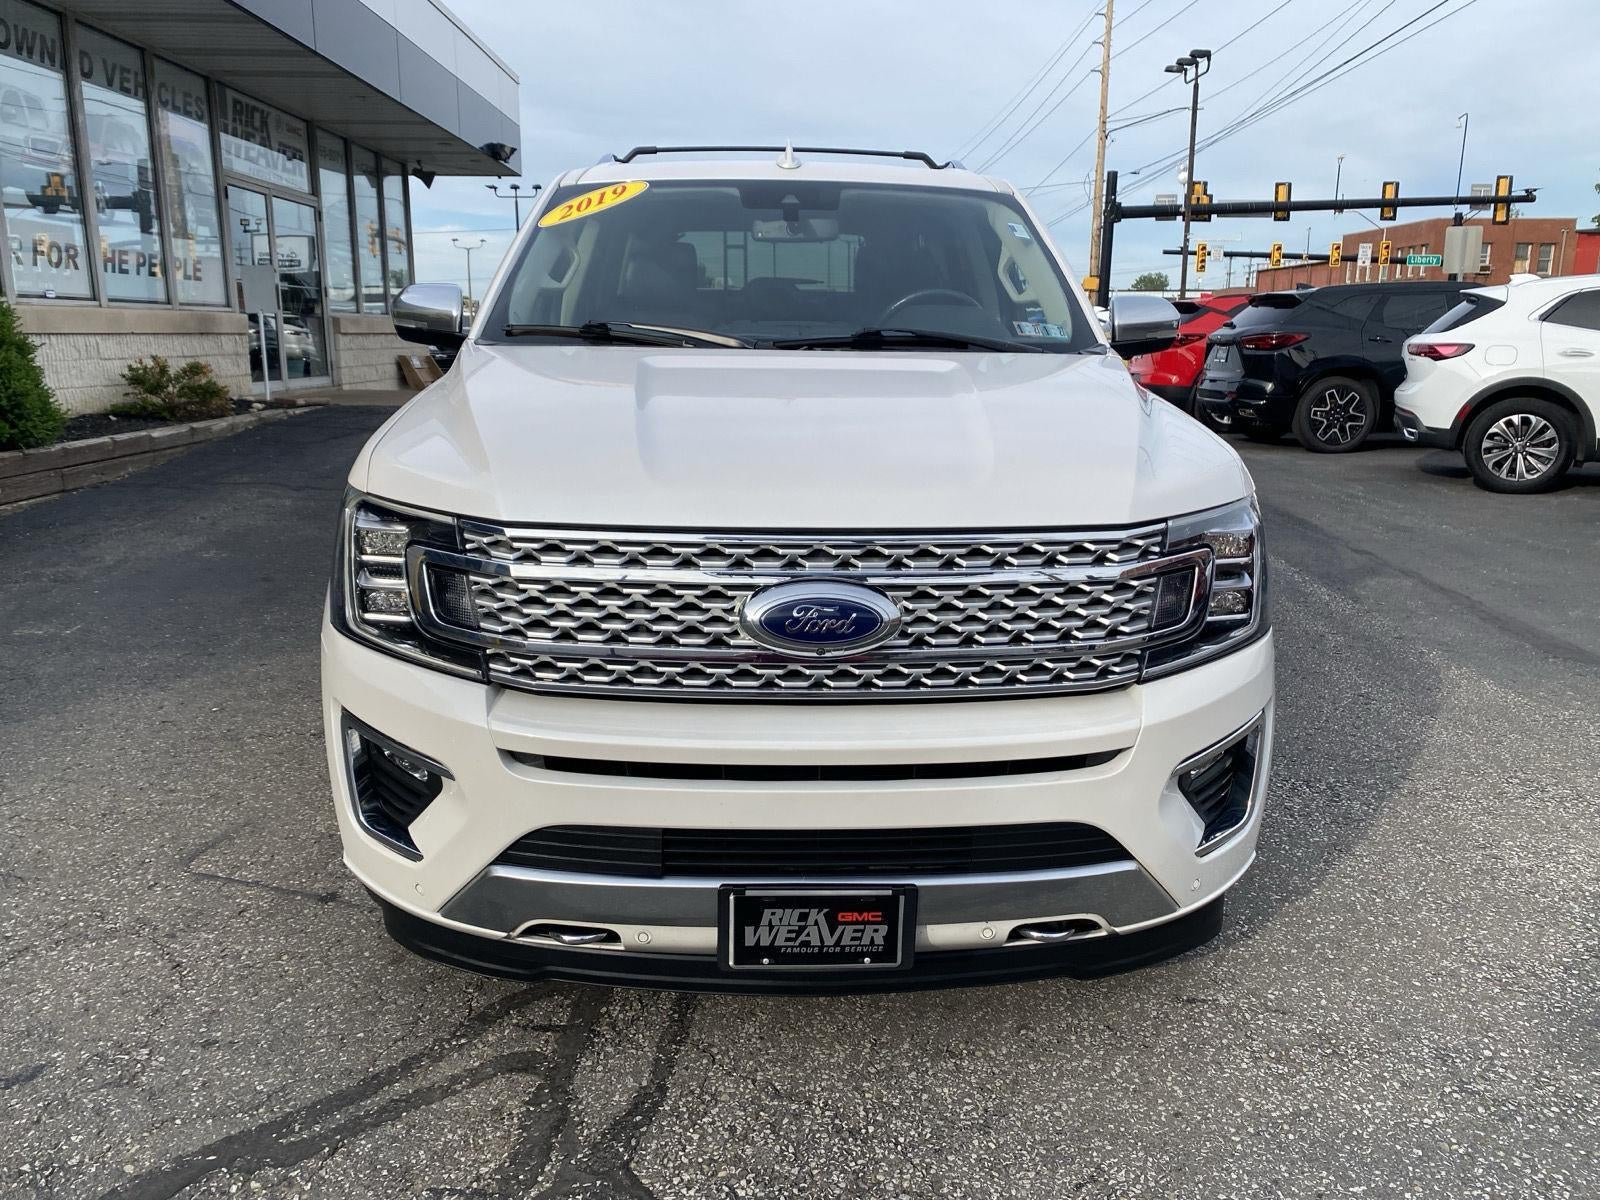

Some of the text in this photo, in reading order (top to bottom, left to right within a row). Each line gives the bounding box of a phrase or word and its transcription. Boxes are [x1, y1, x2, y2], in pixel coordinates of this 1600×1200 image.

[559, 185, 627, 220] 2019
[32, 235, 80, 271] FOR
[1410, 255, 1438, 265] Liberty
[785, 604, 857, 634] Ford
[760, 908, 882, 926] RICK GMC
[744, 924, 888, 947] WEAVER
